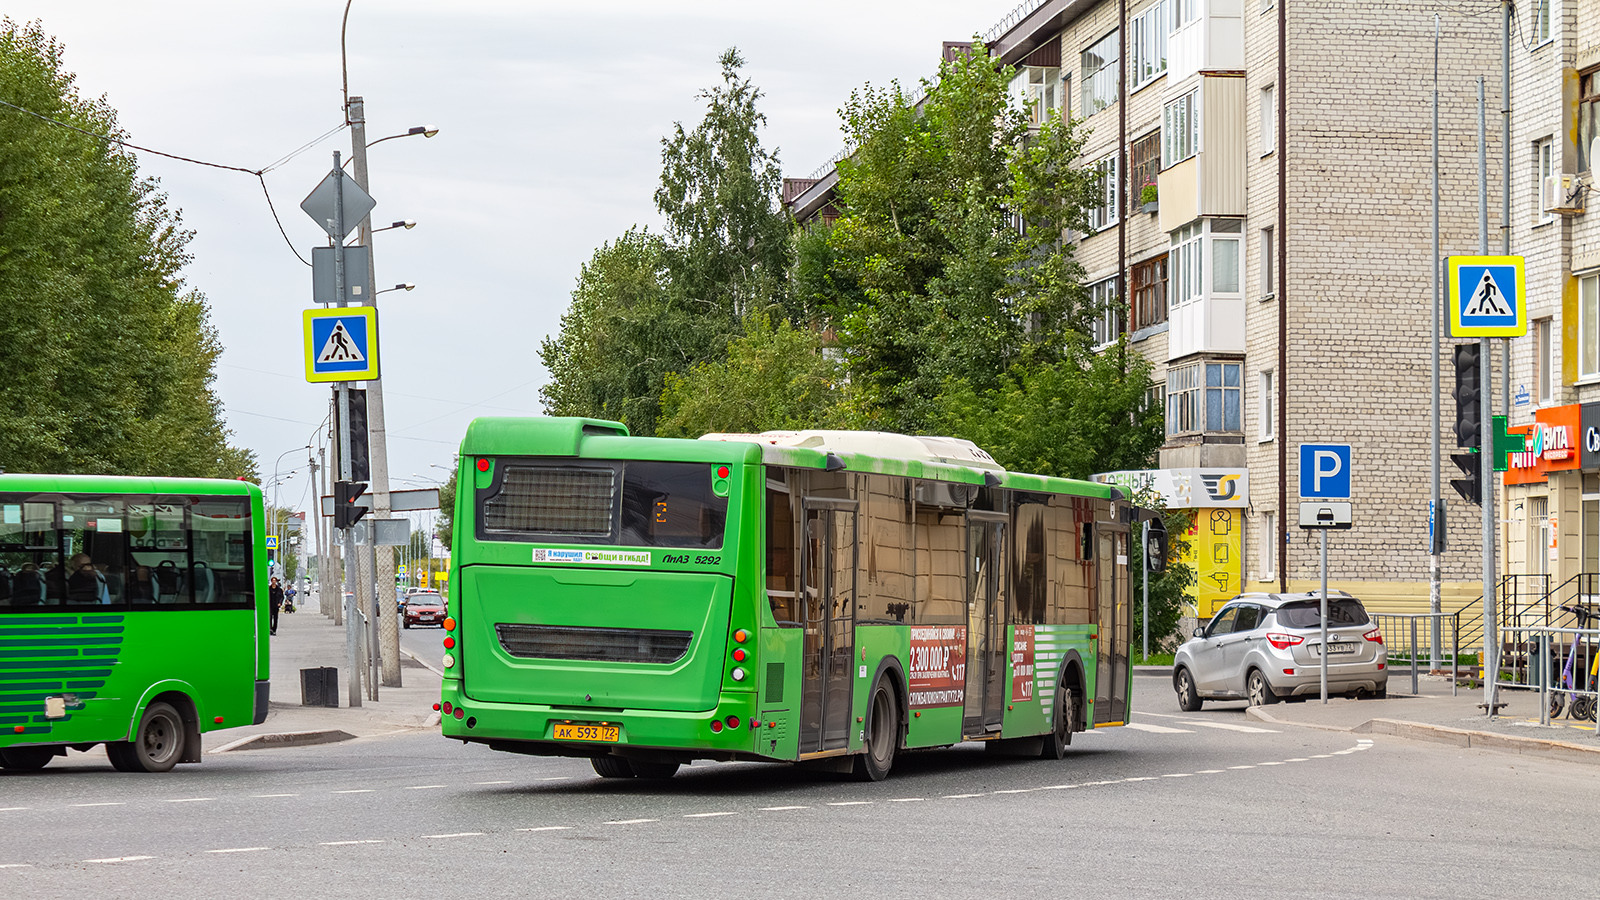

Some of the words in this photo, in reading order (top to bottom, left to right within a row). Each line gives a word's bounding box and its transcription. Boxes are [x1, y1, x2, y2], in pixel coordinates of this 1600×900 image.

[1543, 425, 1568, 450] ВИТА
[1313, 450, 1342, 492] P
[695, 556, 721, 566] 5292
[910, 646, 915, 671] 2
[916, 646, 928, 672] 300
[930, 646, 942, 670] 000
[956, 664, 964, 680] 117
[577, 727, 598, 738] 593
[604, 728, 615, 736] 72
